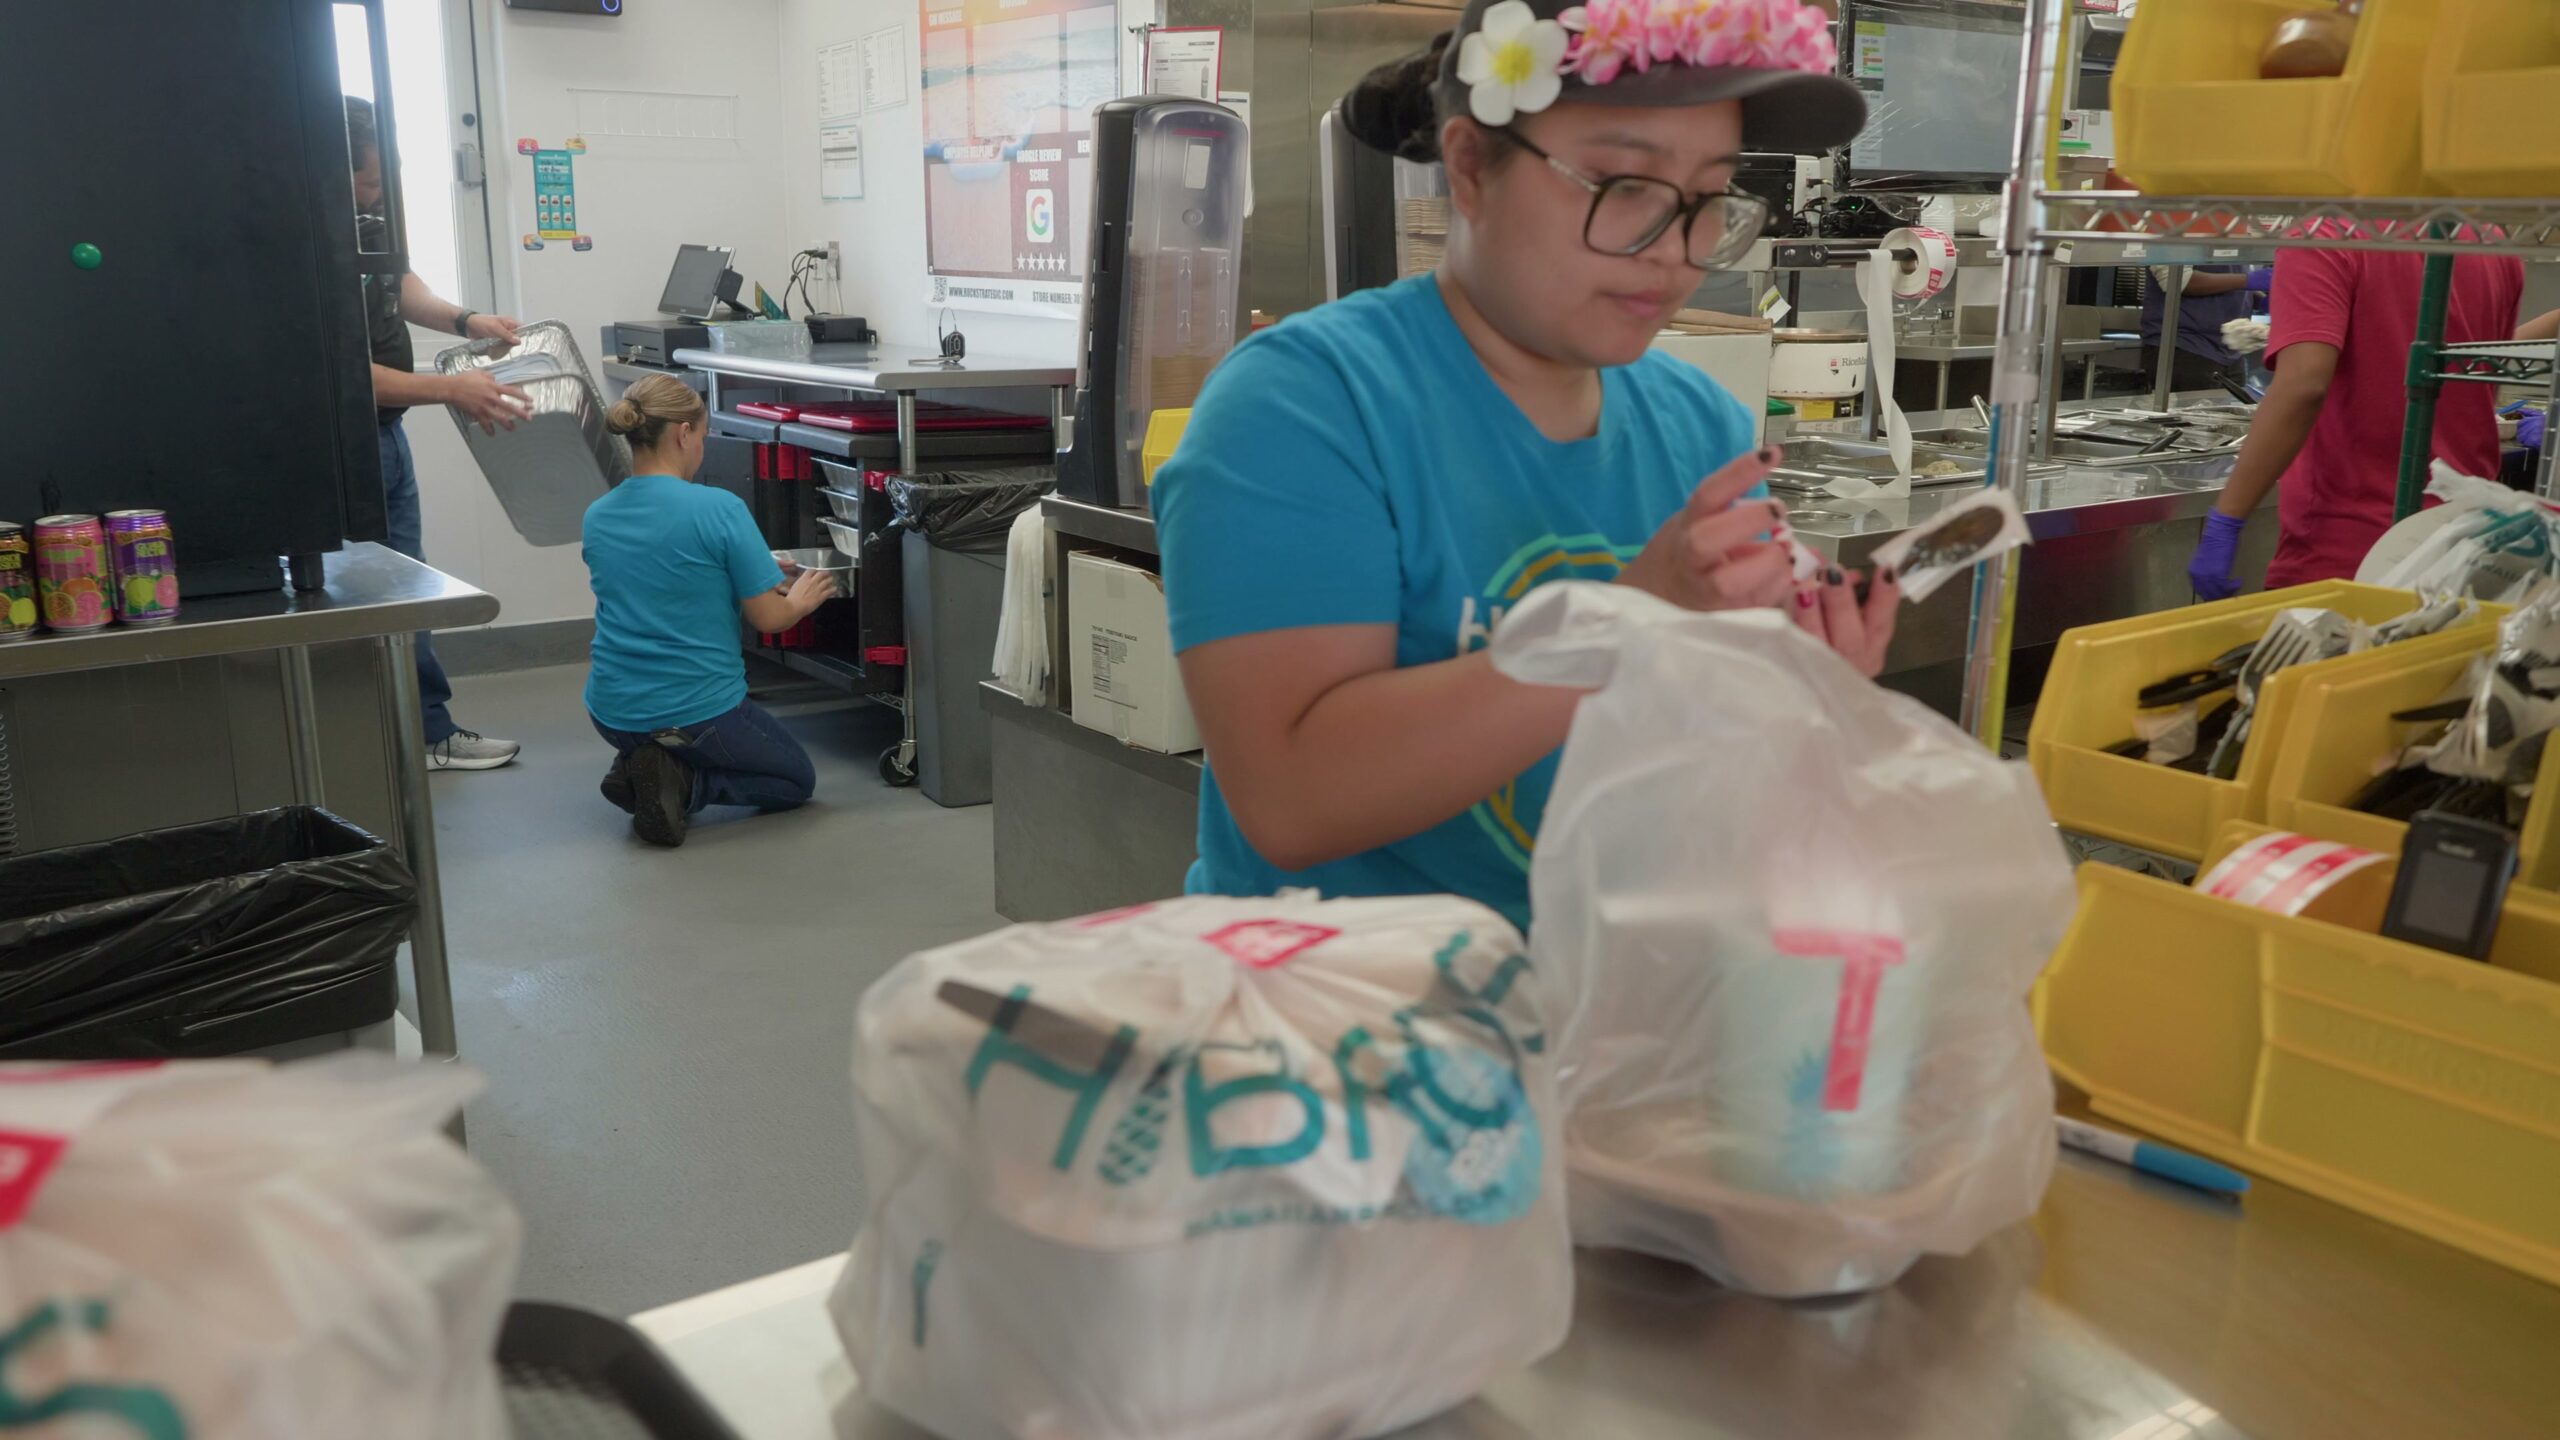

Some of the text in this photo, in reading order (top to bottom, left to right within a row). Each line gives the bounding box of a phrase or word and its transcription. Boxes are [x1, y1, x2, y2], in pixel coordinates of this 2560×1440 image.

[1016, 148, 1062, 163] GOOGLE REVIEW
[1029, 168, 1049, 182] SCORE
[1032, 291, 1049, 303] STORE
